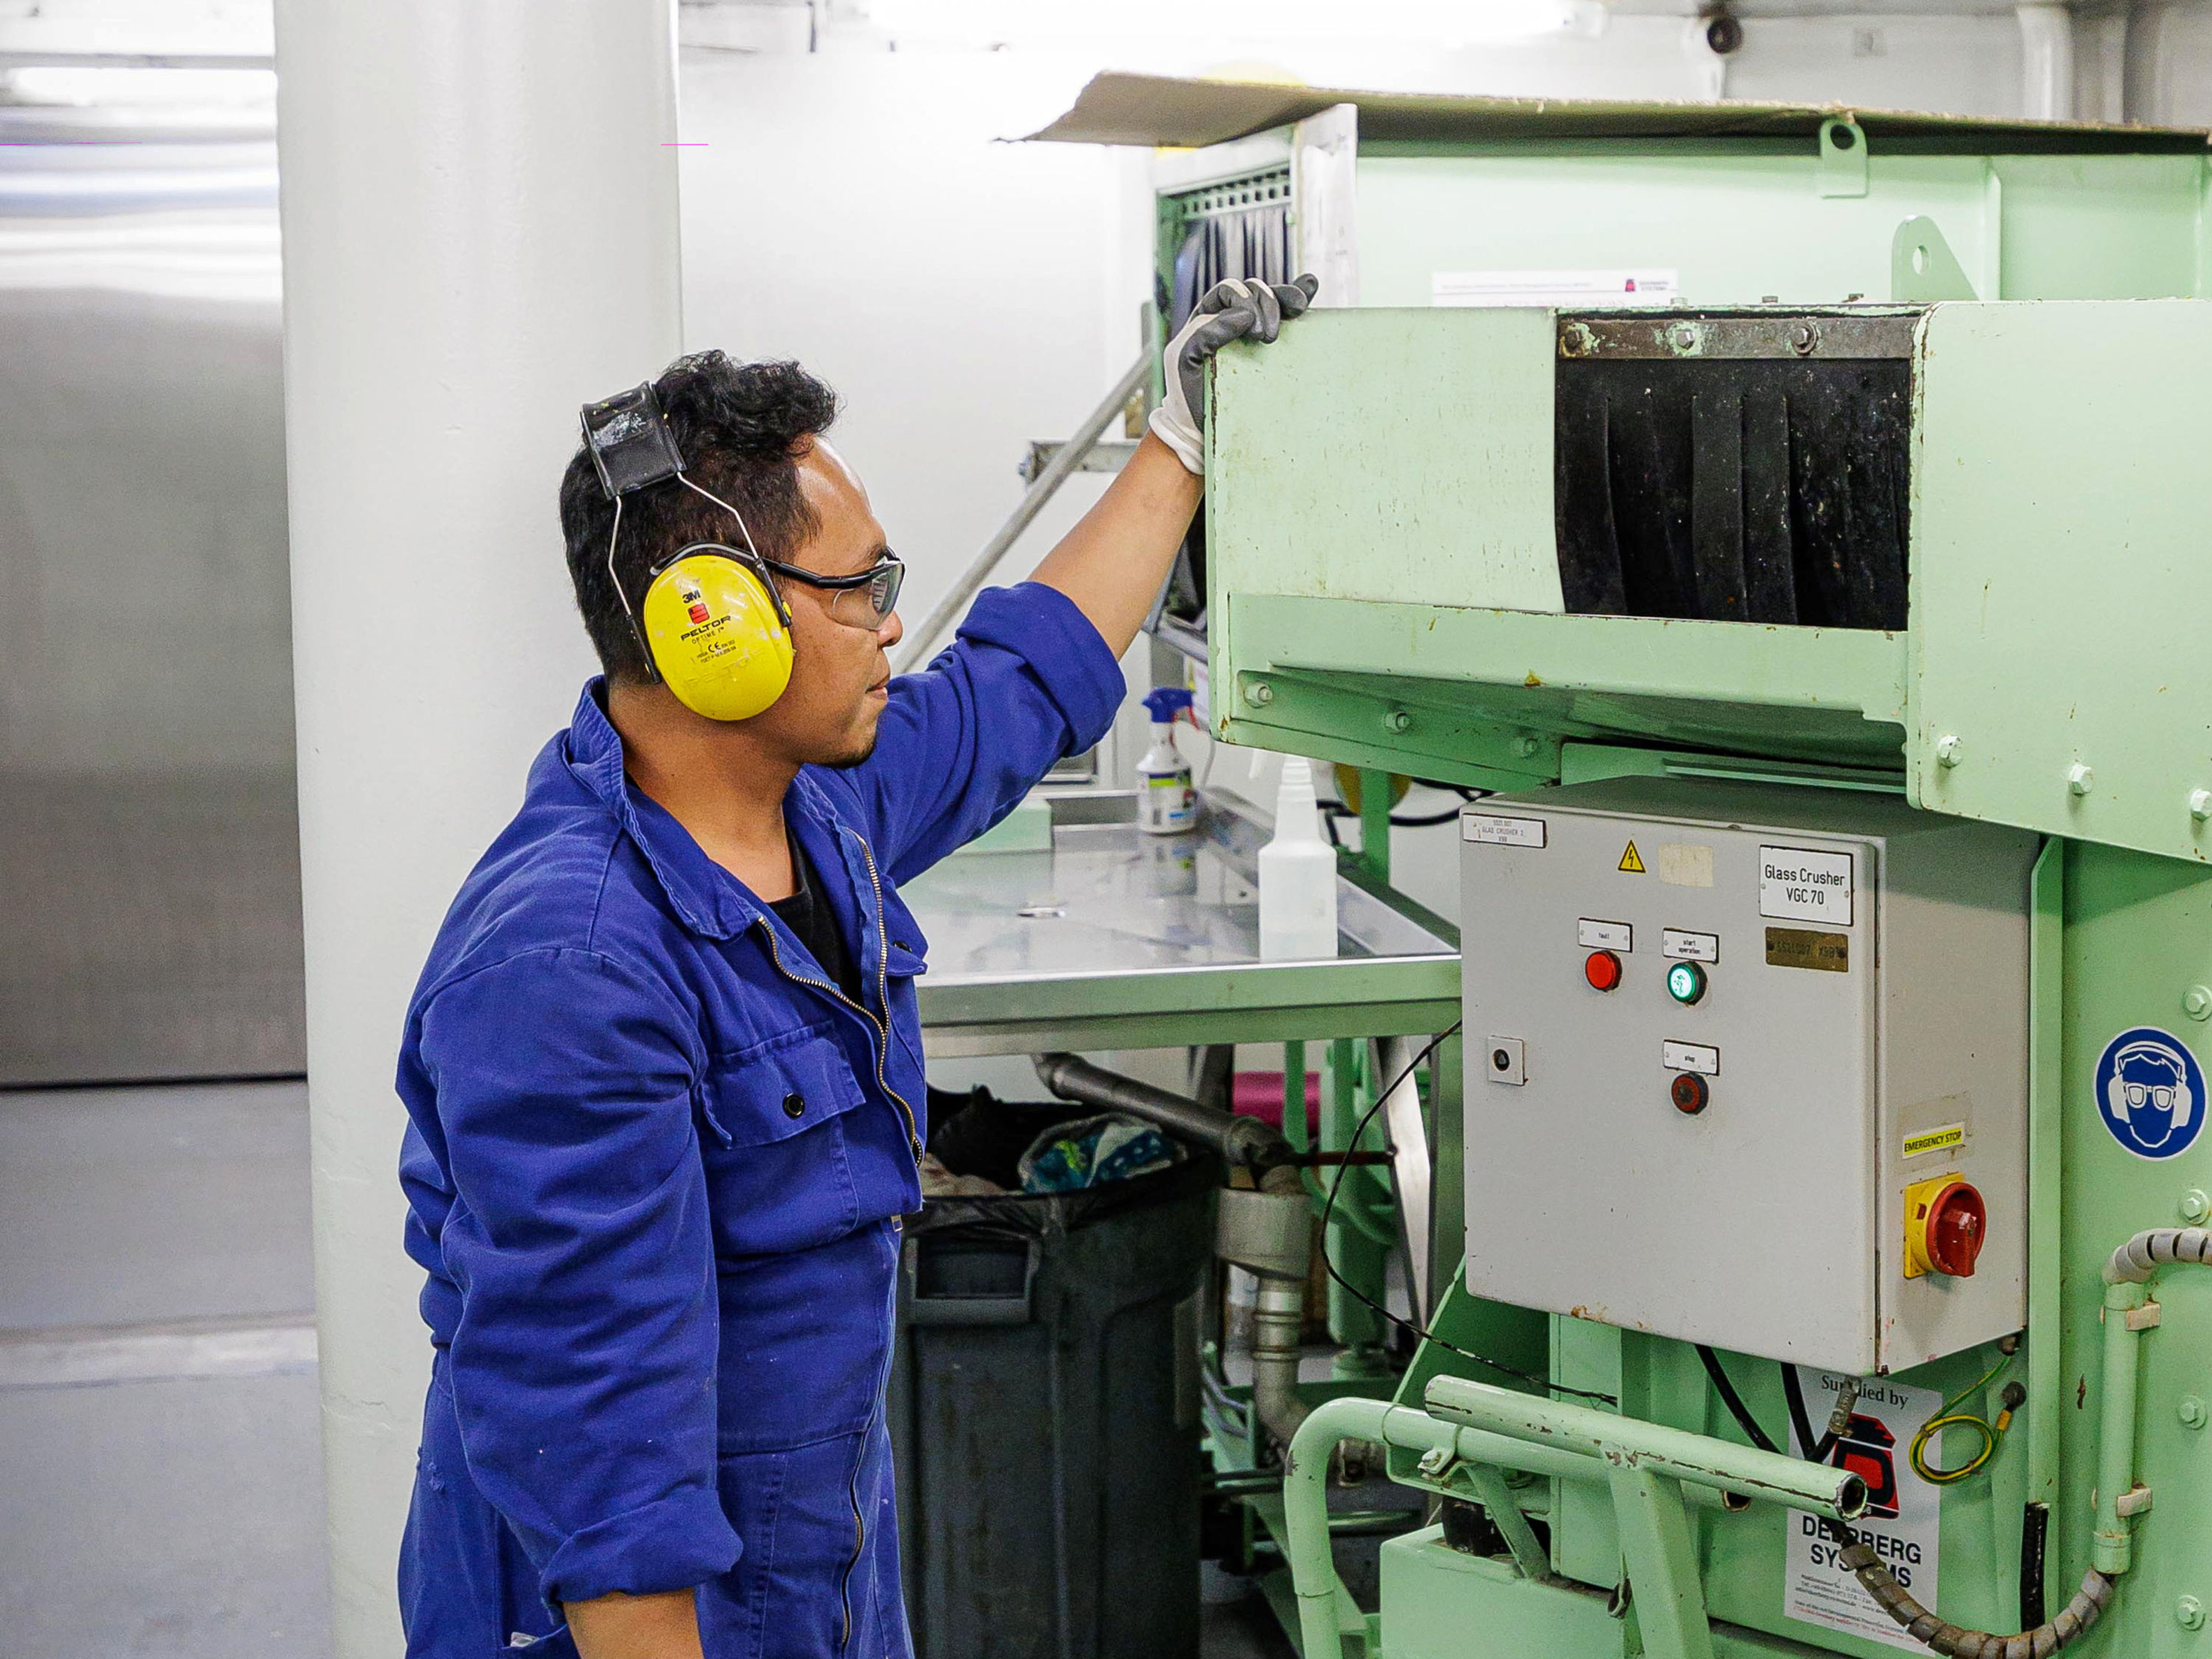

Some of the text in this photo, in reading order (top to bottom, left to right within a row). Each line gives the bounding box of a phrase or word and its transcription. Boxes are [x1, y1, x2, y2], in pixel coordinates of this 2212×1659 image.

[682, 590, 701, 604] 3M
[680, 615, 731, 641] PELTOR
[1764, 864, 1846, 886] Glass Crusher
[1786, 887, 1824, 905] VGC 70
[1904, 1130, 1962, 1152] EMERGENCY STOP
[1821, 1374, 1909, 1410] Sulied by
[1802, 1514, 1921, 1565] DEBERG
